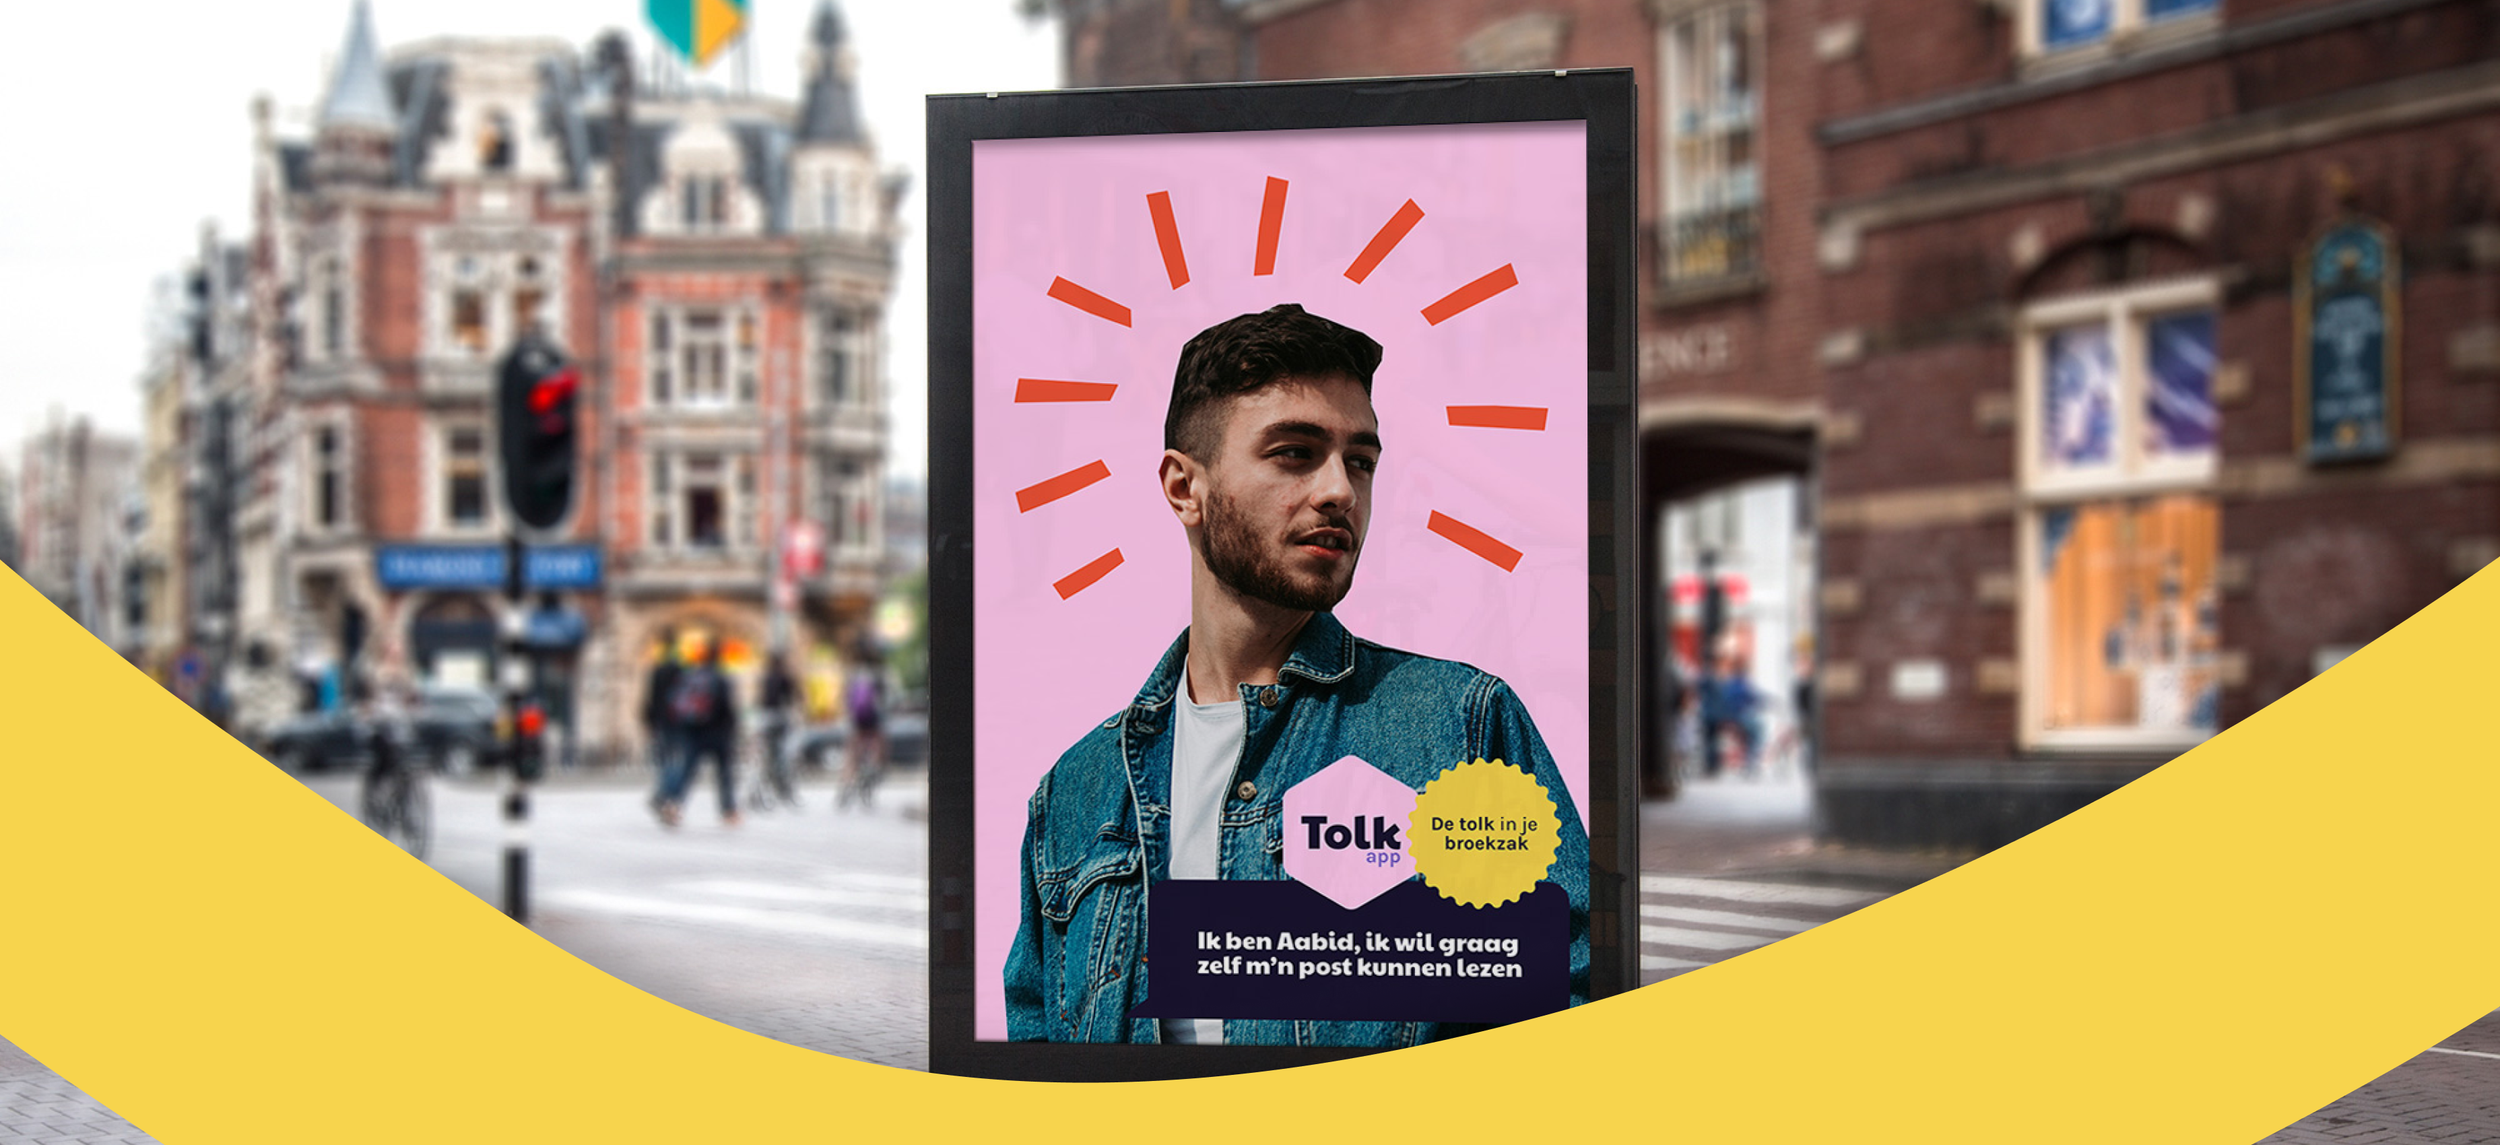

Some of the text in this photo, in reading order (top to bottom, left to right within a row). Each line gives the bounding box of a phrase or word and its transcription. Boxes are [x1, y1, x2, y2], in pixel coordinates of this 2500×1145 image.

[1300, 815, 1402, 851] Tolk
[1431, 816, 1538, 837] De tolk in je
[1445, 835, 1530, 851] broekzak
[1366, 851, 1402, 868] app
[1198, 930, 1519, 958] Ik ben Aabid, ik wil graag
[1197, 955, 1523, 980] zelf m’n post kunnen lezen
